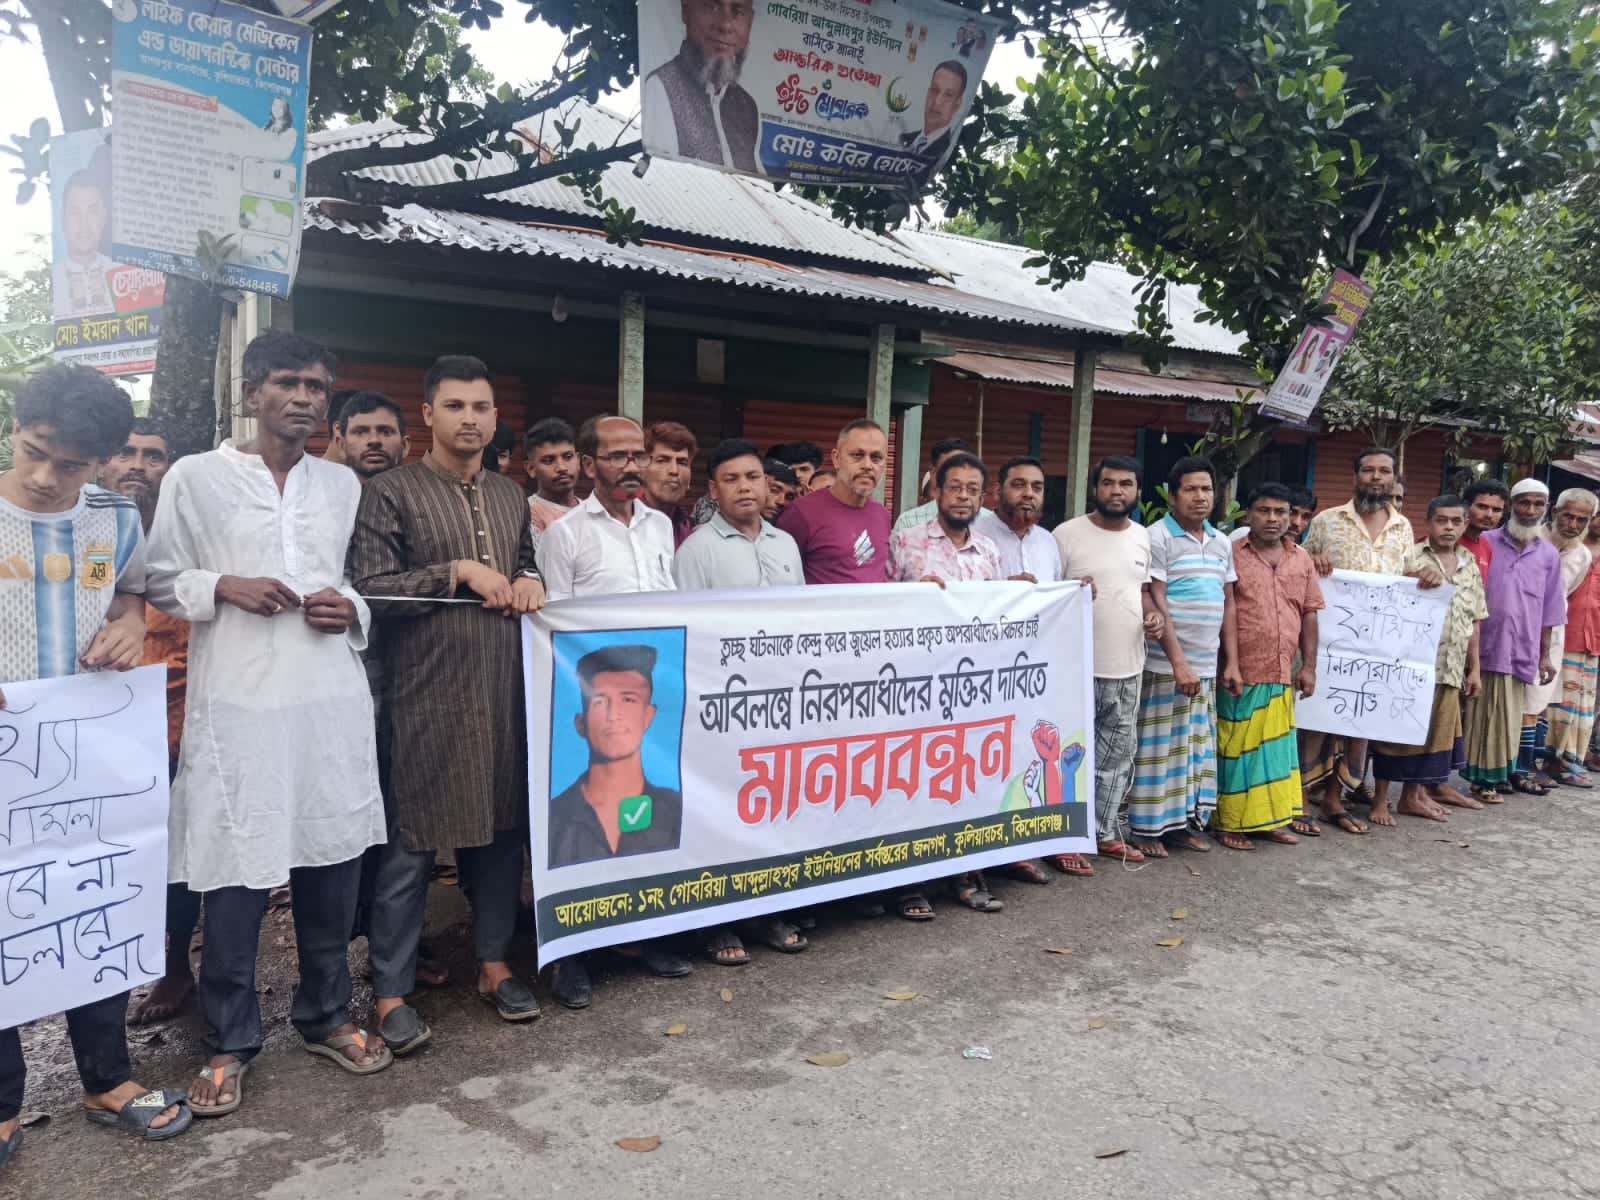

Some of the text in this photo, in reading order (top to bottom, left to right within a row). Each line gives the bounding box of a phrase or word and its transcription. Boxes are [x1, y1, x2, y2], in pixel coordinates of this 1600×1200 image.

[142, 0, 300, 54] লাইফ কেয়ার মেডিকেল
[773, 48, 834, 72] আন্তরিক
[772, 134, 815, 158] মোঃ
[820, 143, 872, 168] কবির
[56, 325, 79, 346] মোঃ
[81, 317, 120, 342] ইমরান
[125, 314, 148, 337] খান
[720, 614, 1039, 667] তুচ্ছ ঘটনাকে কেন্দ্র করে জুয়েল হত্যার প্রকৃত অপরাধীদের বিচার চাই
[700, 651, 1048, 733] অবিলম্বে নিরপরাধীদের মুক্তির দাবিতে
[737, 714, 1016, 825] মানববন্ধন
[638, 887, 665, 913] ১নং
[670, 871, 728, 905] গোবরিয়া
[731, 863, 800, 896] আব্দুল্লাহপুর
[803, 848, 862, 880] ইউনিয়নের
[865, 839, 908, 868] সর্বস্তরের
[912, 834, 951, 858] জনগণ,
[954, 824, 1009, 856] কুলিয়ারচর,
